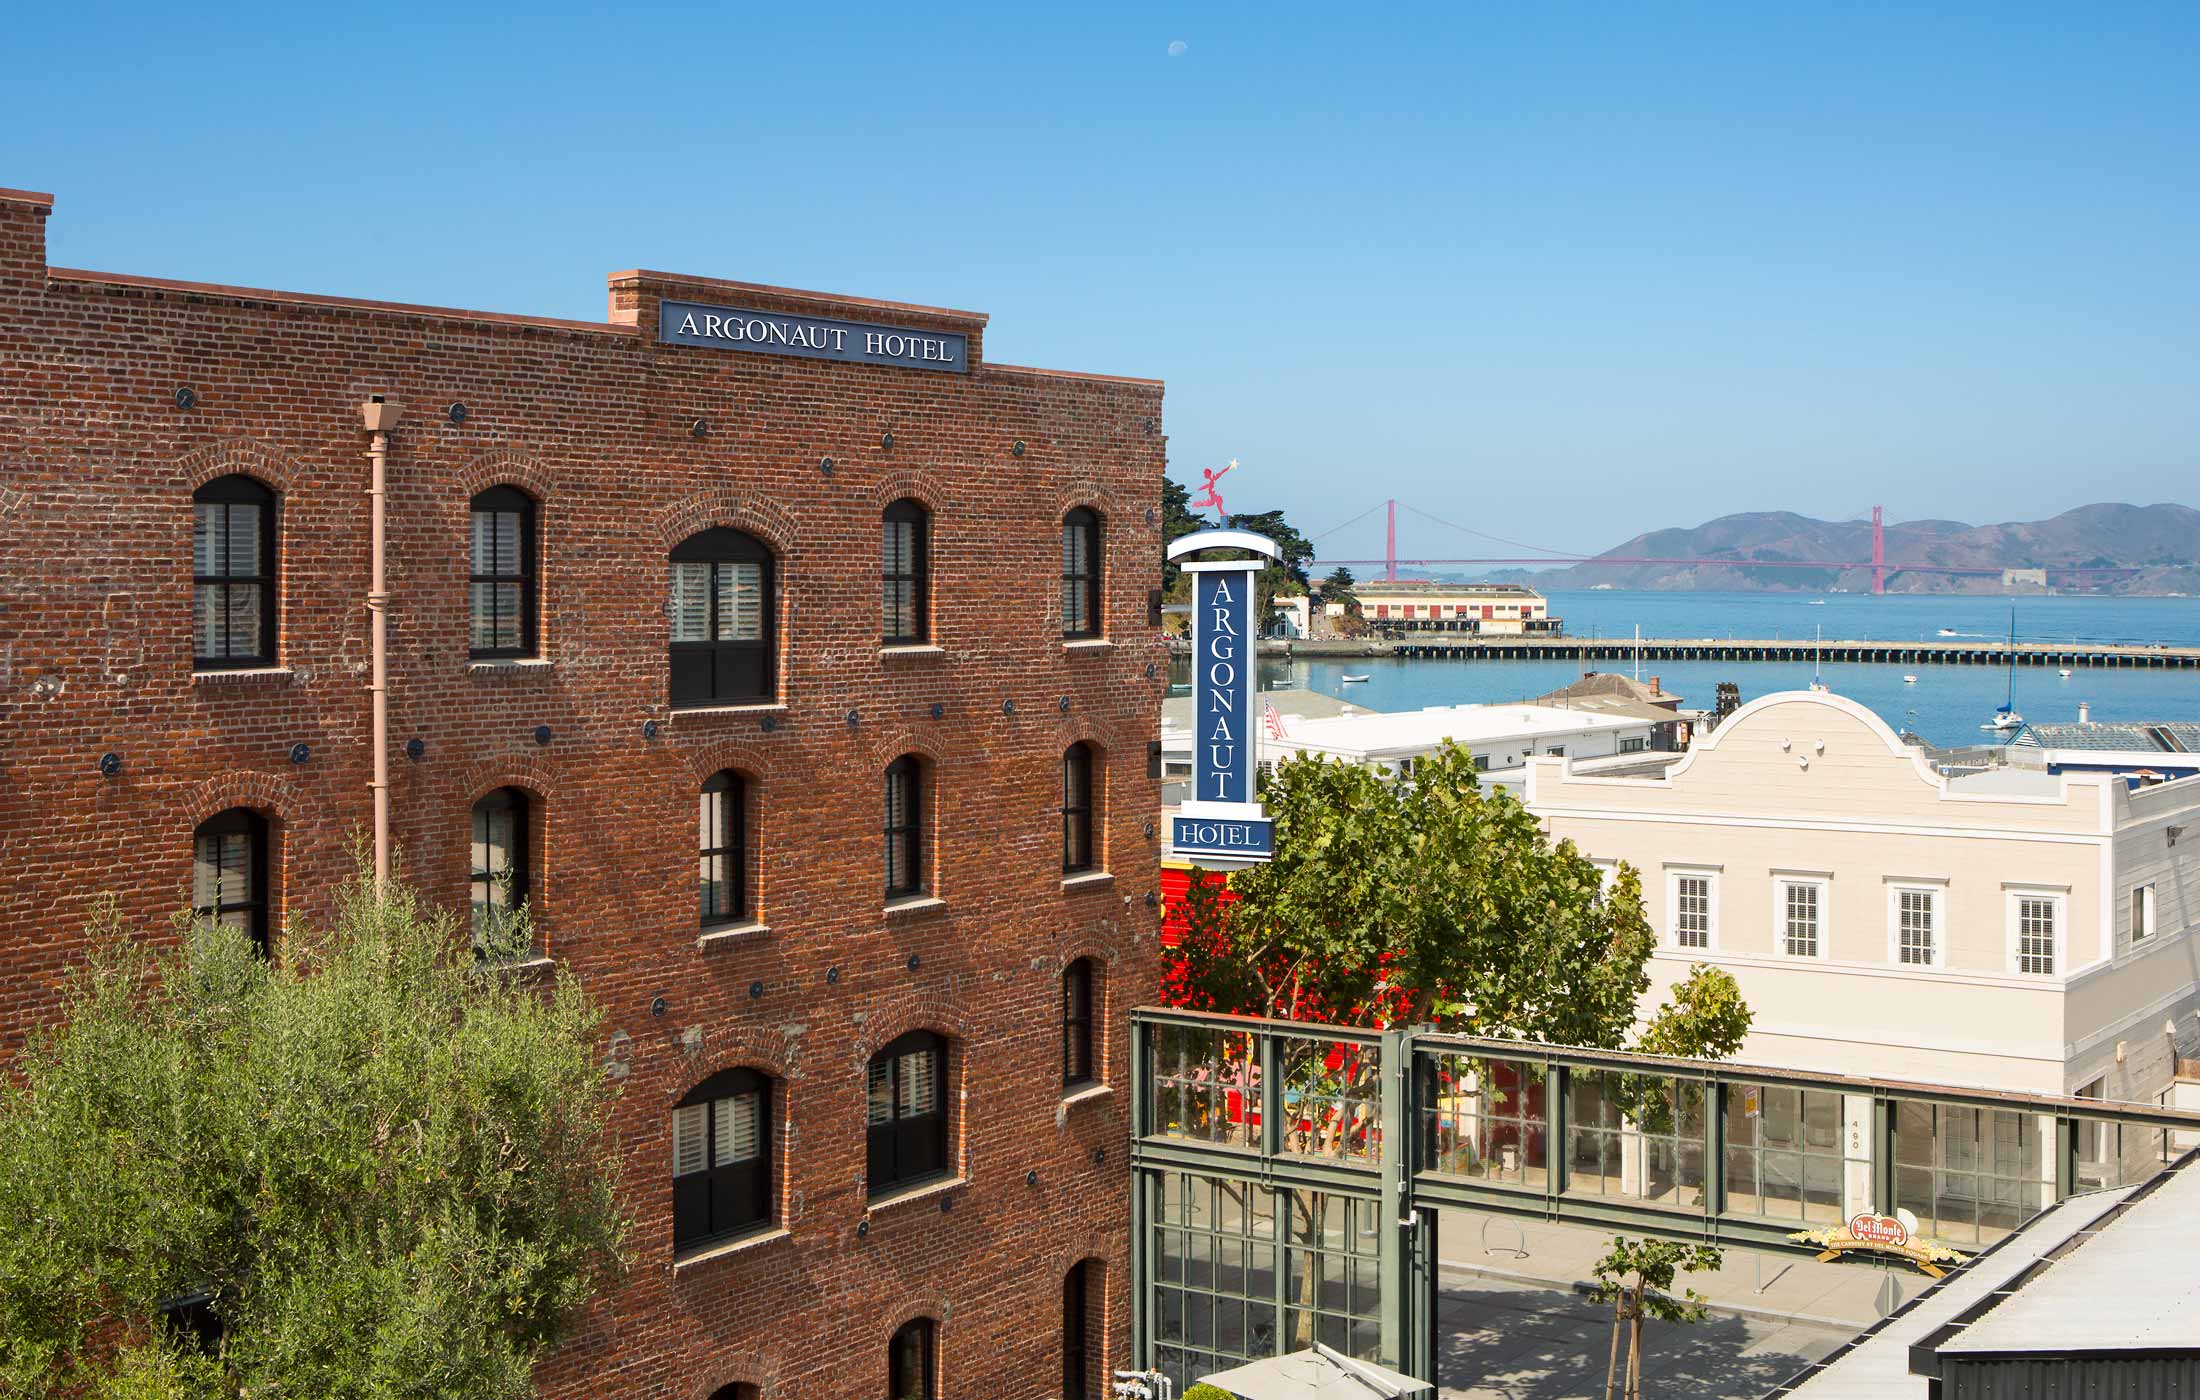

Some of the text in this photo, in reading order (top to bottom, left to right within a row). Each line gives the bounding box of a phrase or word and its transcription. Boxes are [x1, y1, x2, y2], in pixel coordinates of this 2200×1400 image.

[677, 311, 954, 362] ARGONAUT HOTEL
[1210, 578, 1239, 799] ARGONAUT
[1180, 823, 1261, 847] HOTEL
[1855, 1220, 1902, 1236] Del Monte
